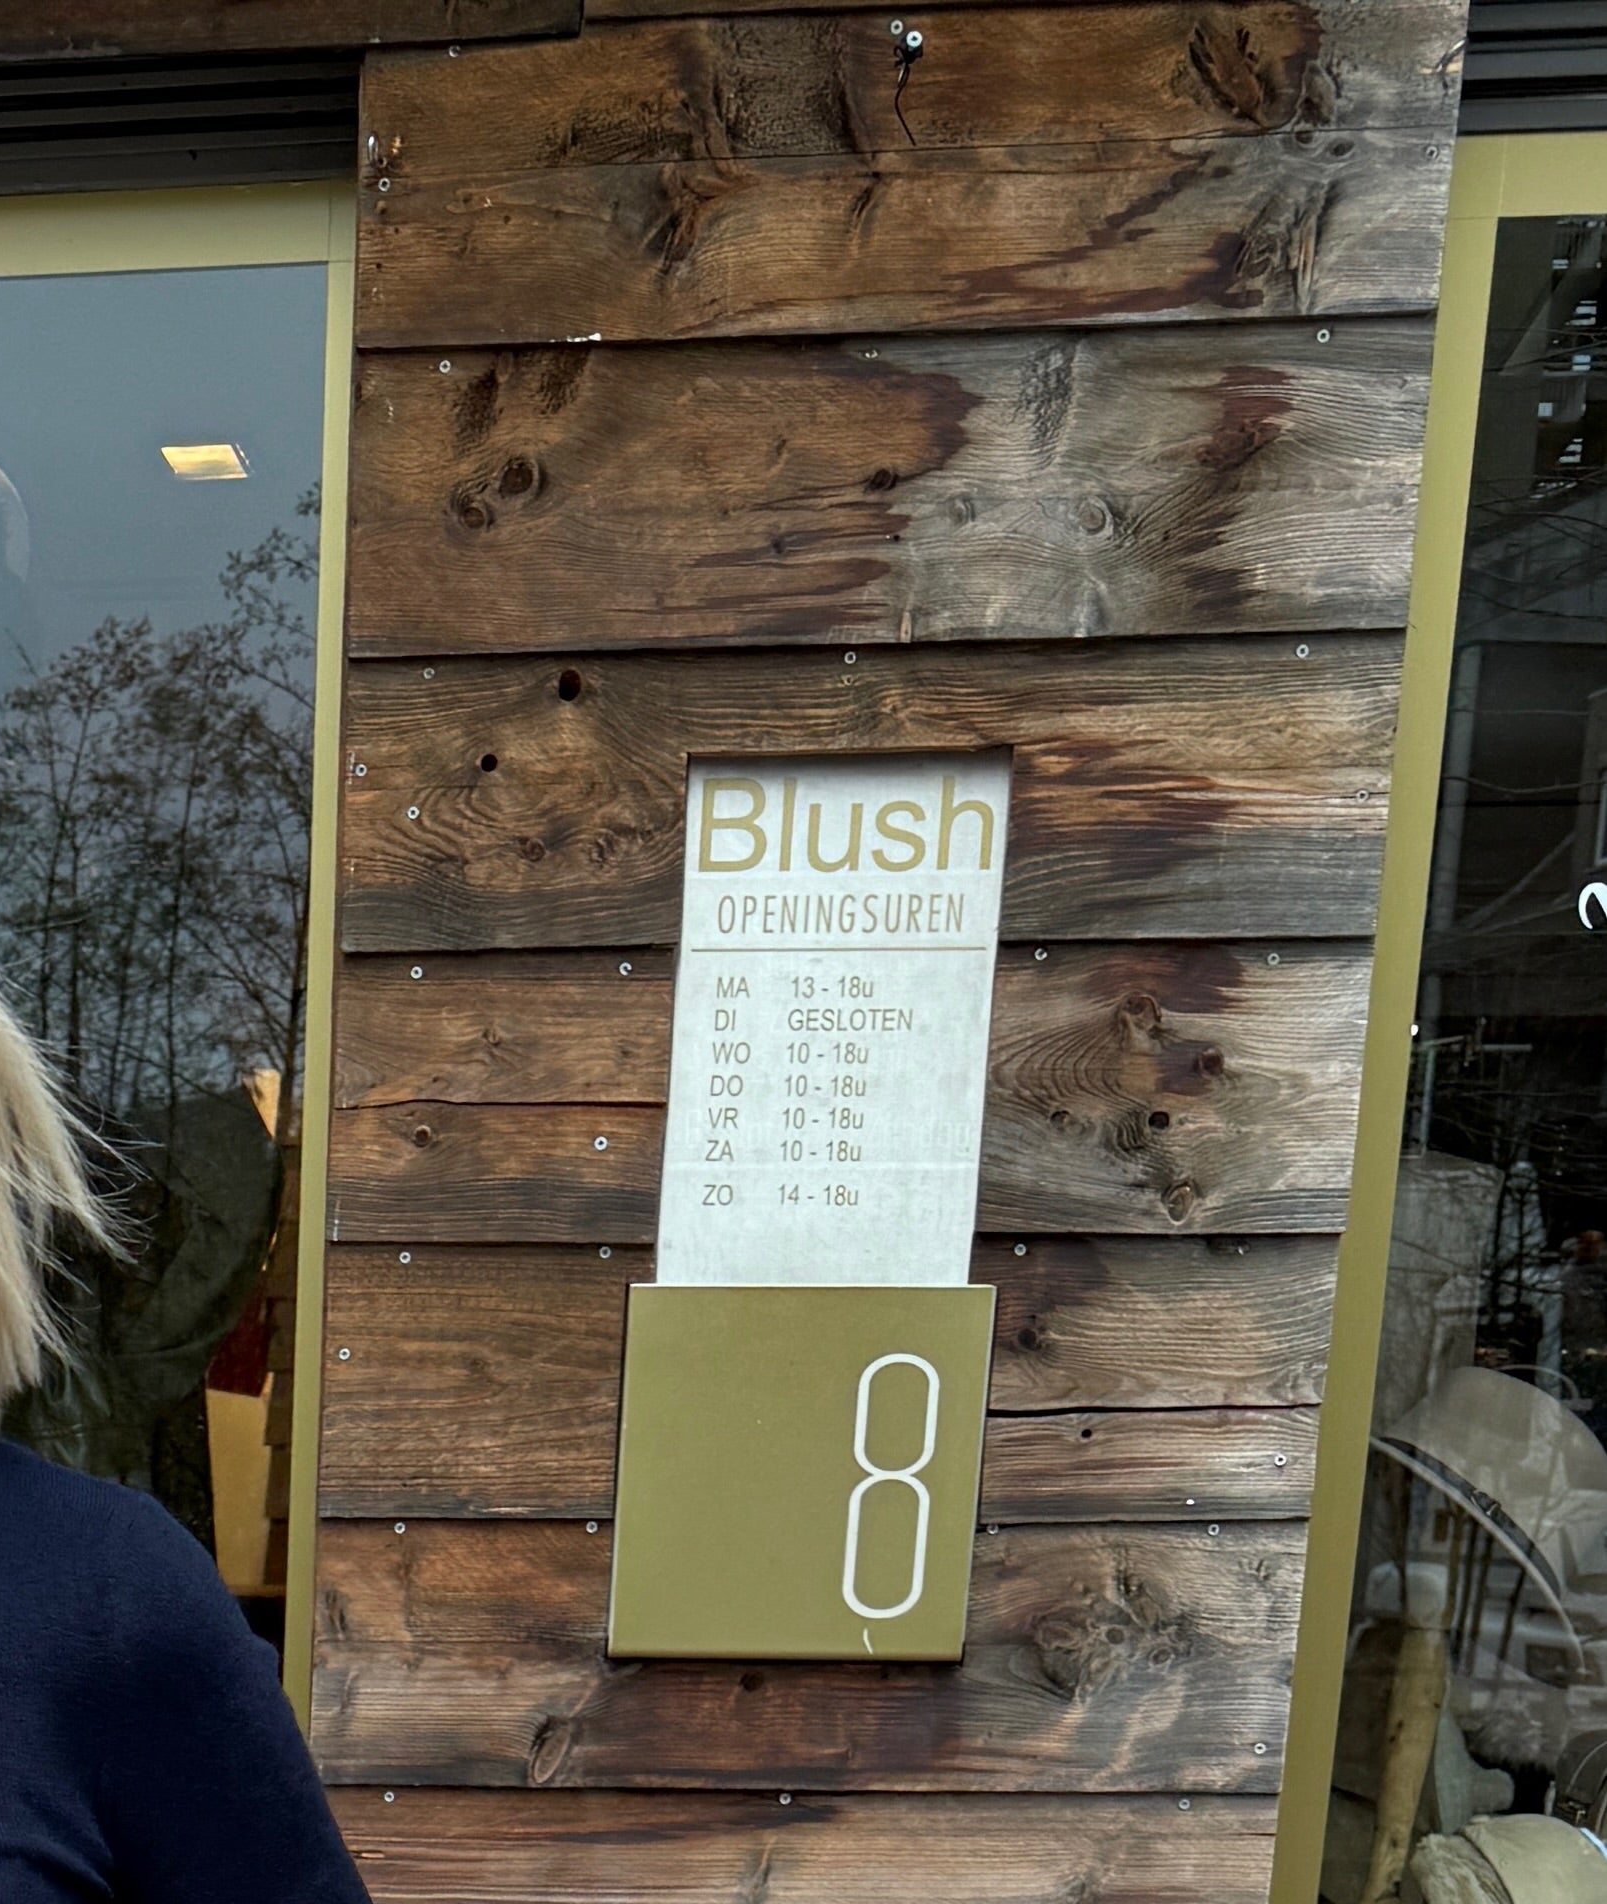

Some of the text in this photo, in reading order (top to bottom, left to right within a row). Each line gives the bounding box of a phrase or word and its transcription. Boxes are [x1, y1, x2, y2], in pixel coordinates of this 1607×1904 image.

[697, 776, 995, 873] Blush
[718, 893, 965, 934] OPENINGSUREN
[717, 976, 750, 999] MA
[791, 976, 815, 999] 13
[838, 976, 874, 999] 18u
[714, 1008, 913, 1032] DI GESLOTEN
[712, 1041, 751, 1064] WO
[787, 1042, 810, 1064] 10
[833, 1042, 869, 1064] 18u
[710, 1074, 743, 1097] DO
[785, 1074, 807, 1097] 10
[831, 1075, 867, 1097] 18u
[708, 1107, 738, 1129] VR
[783, 1107, 805, 1130] 10
[829, 1107, 864, 1129] 18u
[705, 1139, 734, 1162] ZA
[780, 1140, 802, 1161] 10
[826, 1140, 861, 1162] 18u
[702, 1184, 733, 1206] ZO
[778, 1184, 799, 1205] 14
[824, 1184, 858, 1206] 18u
[842, 1353, 940, 1619] 8
